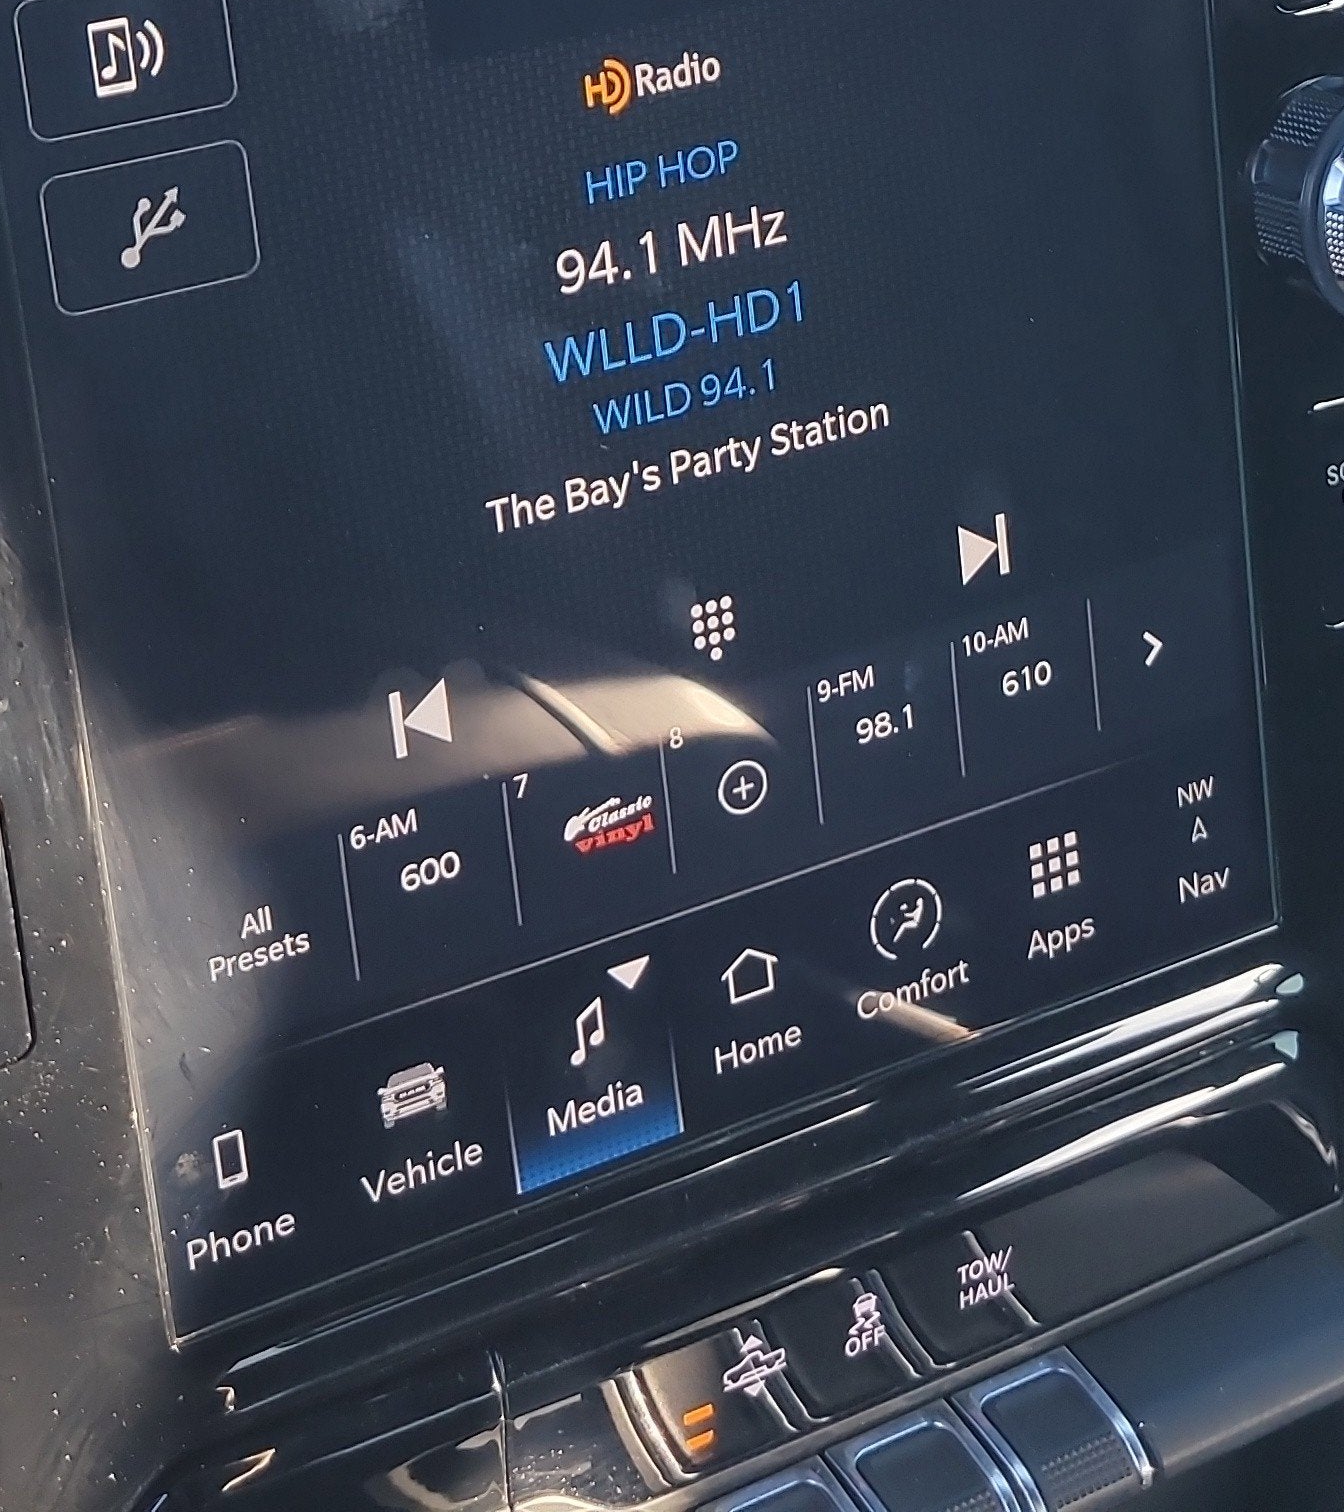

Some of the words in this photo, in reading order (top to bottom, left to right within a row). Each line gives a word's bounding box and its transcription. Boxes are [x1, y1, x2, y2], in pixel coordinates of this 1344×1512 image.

[634, 51, 721, 98] Radio
[585, 159, 648, 205] HIP
[658, 139, 739, 188] HOP
[556, 230, 659, 295] 94.1
[678, 206, 788, 266] MHz
[544, 280, 804, 383] WLLD-HD1
[593, 383, 691, 434] WILD
[701, 358, 777, 406] 94.1
[486, 489, 556, 534] The
[565, 461, 661, 514] Bay's
[670, 435, 761, 486] Party
[771, 400, 890, 456] Station
[962, 617, 1030, 657] 10-AM
[817, 666, 875, 703] 9-FM
[1002, 660, 1052, 697] 610
[669, 727, 684, 750] 8
[856, 704, 915, 744] 98.1
[513, 774, 529, 798] 7
[1177, 776, 1214, 807] NW
[350, 809, 418, 850] 6-AM
[401, 851, 461, 892] 600
[1178, 867, 1230, 903] Nav
[240, 906, 273, 940] All
[1028, 916, 1096, 959] Apps
[209, 931, 310, 982] Presets
[857, 959, 970, 1021] Comfort
[714, 1025, 803, 1075] Home
[547, 1081, 644, 1138] Media
[361, 1141, 485, 1204] Vehicle
[186, 1211, 296, 1271] Phone
[958, 1245, 1013, 1284] TOW/
[959, 1275, 1015, 1310] HAUL
[845, 1326, 888, 1357] OFF
